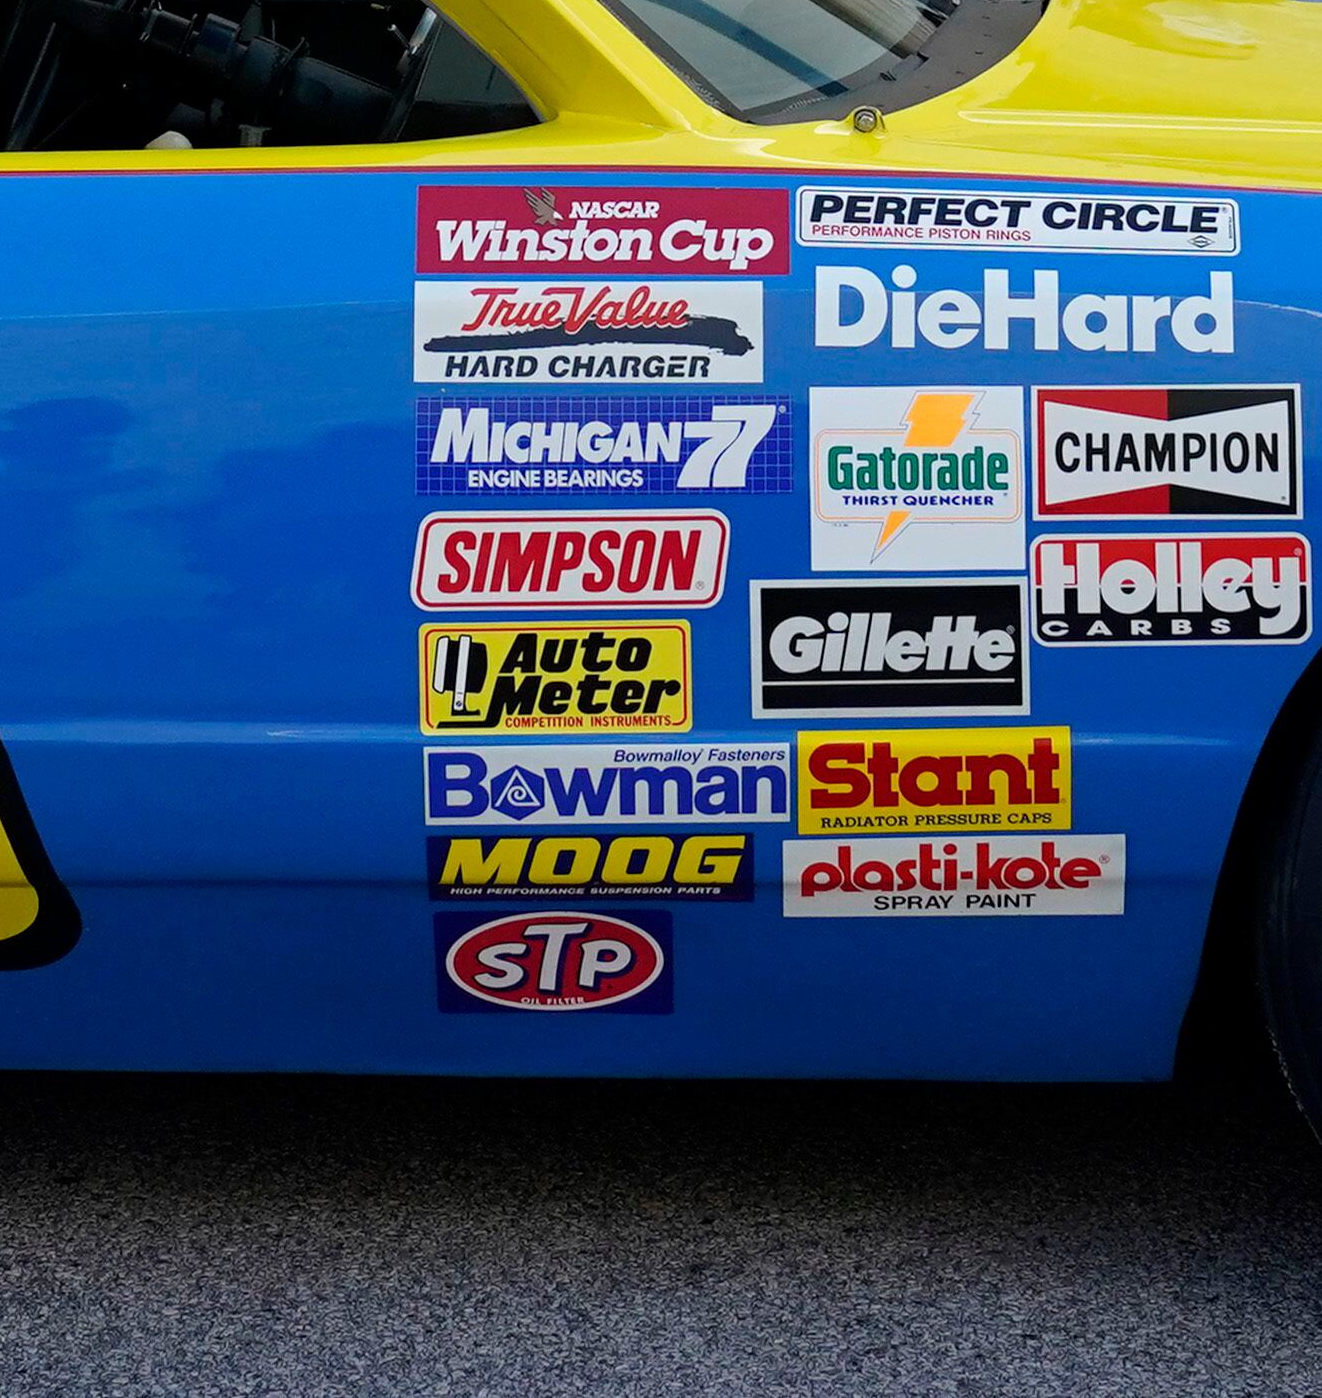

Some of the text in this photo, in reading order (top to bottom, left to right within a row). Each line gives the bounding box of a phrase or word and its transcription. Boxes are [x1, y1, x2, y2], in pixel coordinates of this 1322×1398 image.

[569, 201, 661, 220] NASCAR
[810, 195, 1032, 229] PERFECT
[1041, 199, 1221, 234] CIRCLE
[435, 219, 775, 271] Winston Cup
[812, 224, 1032, 242] PERFORMANCE PISTON RINGS
[814, 264, 1235, 354] DieHard
[444, 355, 712, 379] HARD CHARGER
[429, 404, 777, 489] MICHIGAN 77
[828, 445, 1009, 491] Gatorade
[1055, 431, 1279, 474] CHAMPION
[467, 469, 644, 488] ENGINE BEARINGS
[842, 495, 994, 506] THIRST QUENCHER
[437, 529, 703, 594] SIMPSON
[1040, 541, 1302, 636] Holley
[769, 612, 1016, 673] Gillette
[1041, 618, 1232, 637] CARBS
[498, 632, 654, 675] Auto
[493, 674, 682, 717] Meter
[505, 714, 672, 729] COMPETITION INSTRUMENTS
[613, 748, 786, 765] Bowmalloy Fasteners
[808, 737, 1061, 810] Stant
[428, 752, 788, 821] Bowman
[820, 812, 1053, 829] RADIATOR PRESSURE CAPS
[438, 835, 747, 885] MOOG
[800, 842, 1103, 898] plasti-kote
[449, 886, 722, 896] HIGH PERFORMANCE SUSPENSION PARTS
[873, 893, 1037, 911] SPRAY PAINT
[473, 921, 633, 992] STP
[521, 995, 586, 1006] OIL FILTER
